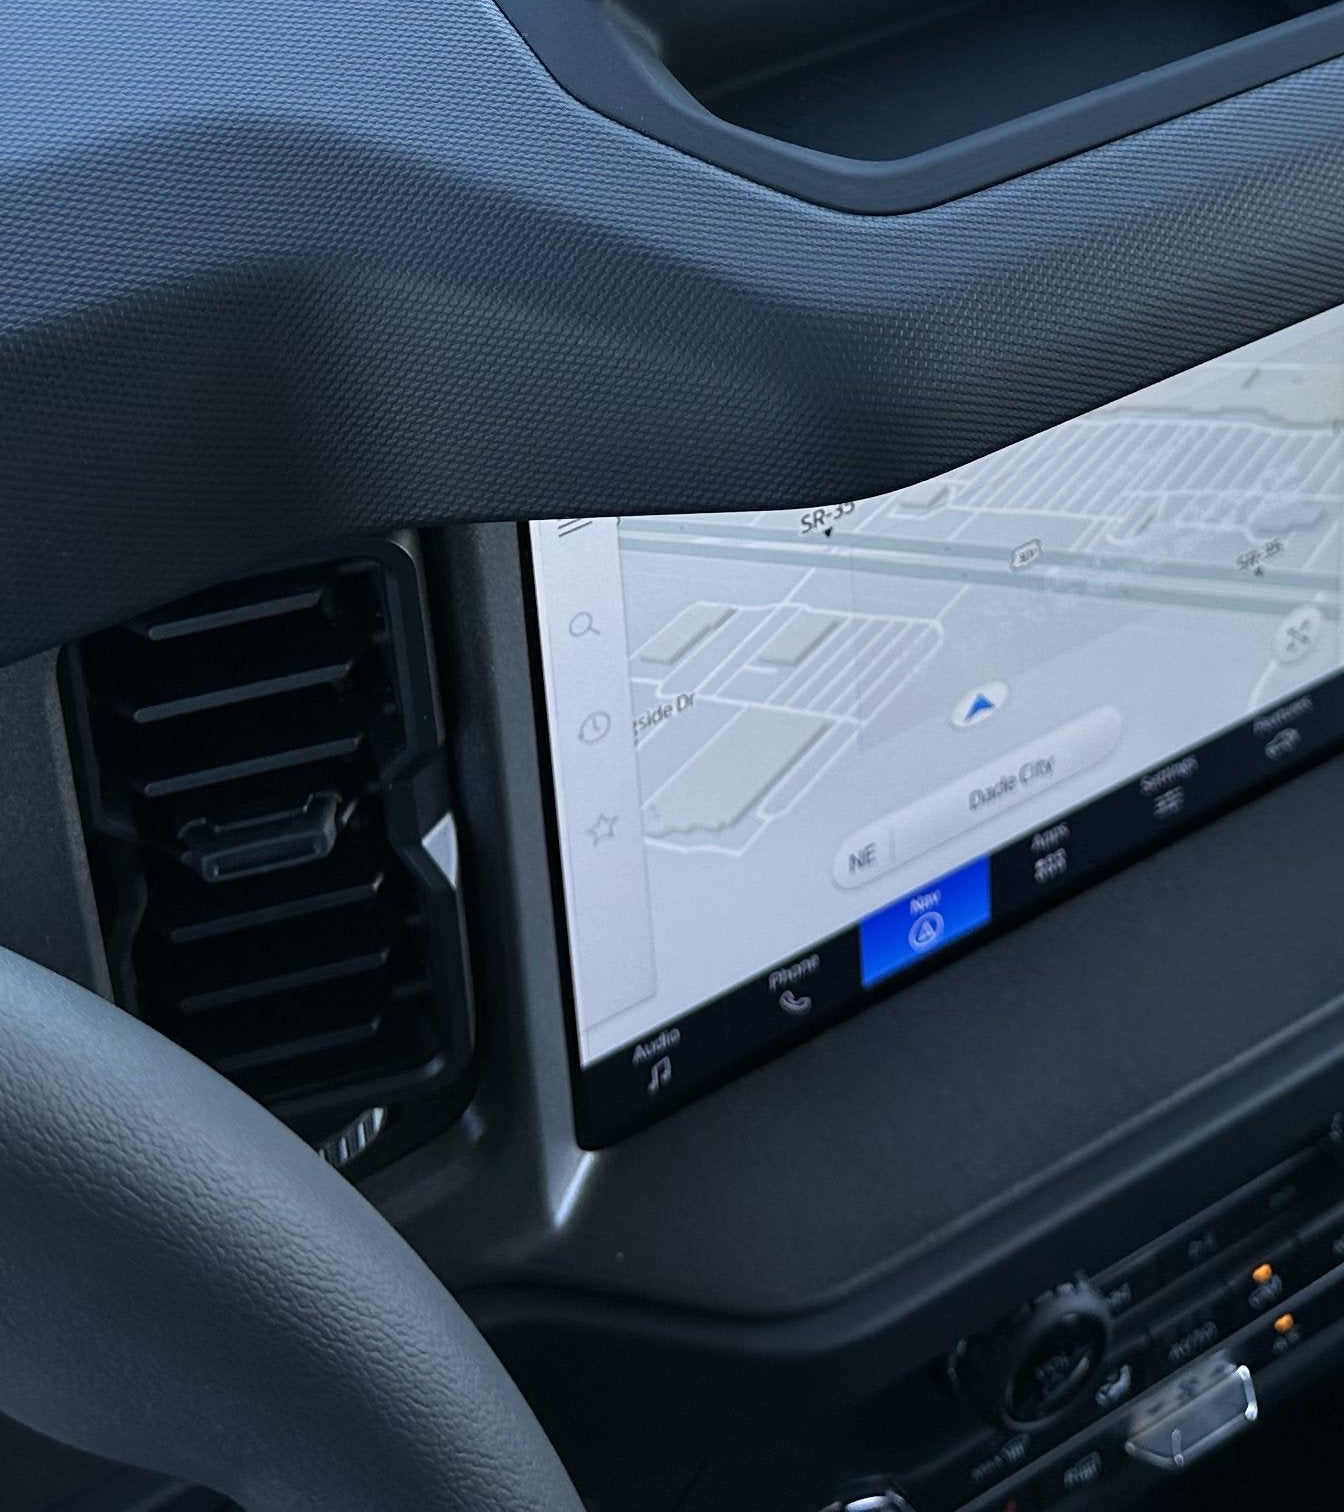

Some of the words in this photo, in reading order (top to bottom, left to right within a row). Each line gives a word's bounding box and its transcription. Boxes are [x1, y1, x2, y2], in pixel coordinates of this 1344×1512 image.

[968, 770, 1016, 810] Dade
[1017, 755, 1055, 786] City
[848, 841, 876, 873] NE
[910, 888, 942, 916] Nav
[769, 954, 820, 991] Phone
[632, 1028, 681, 1065] Audio
